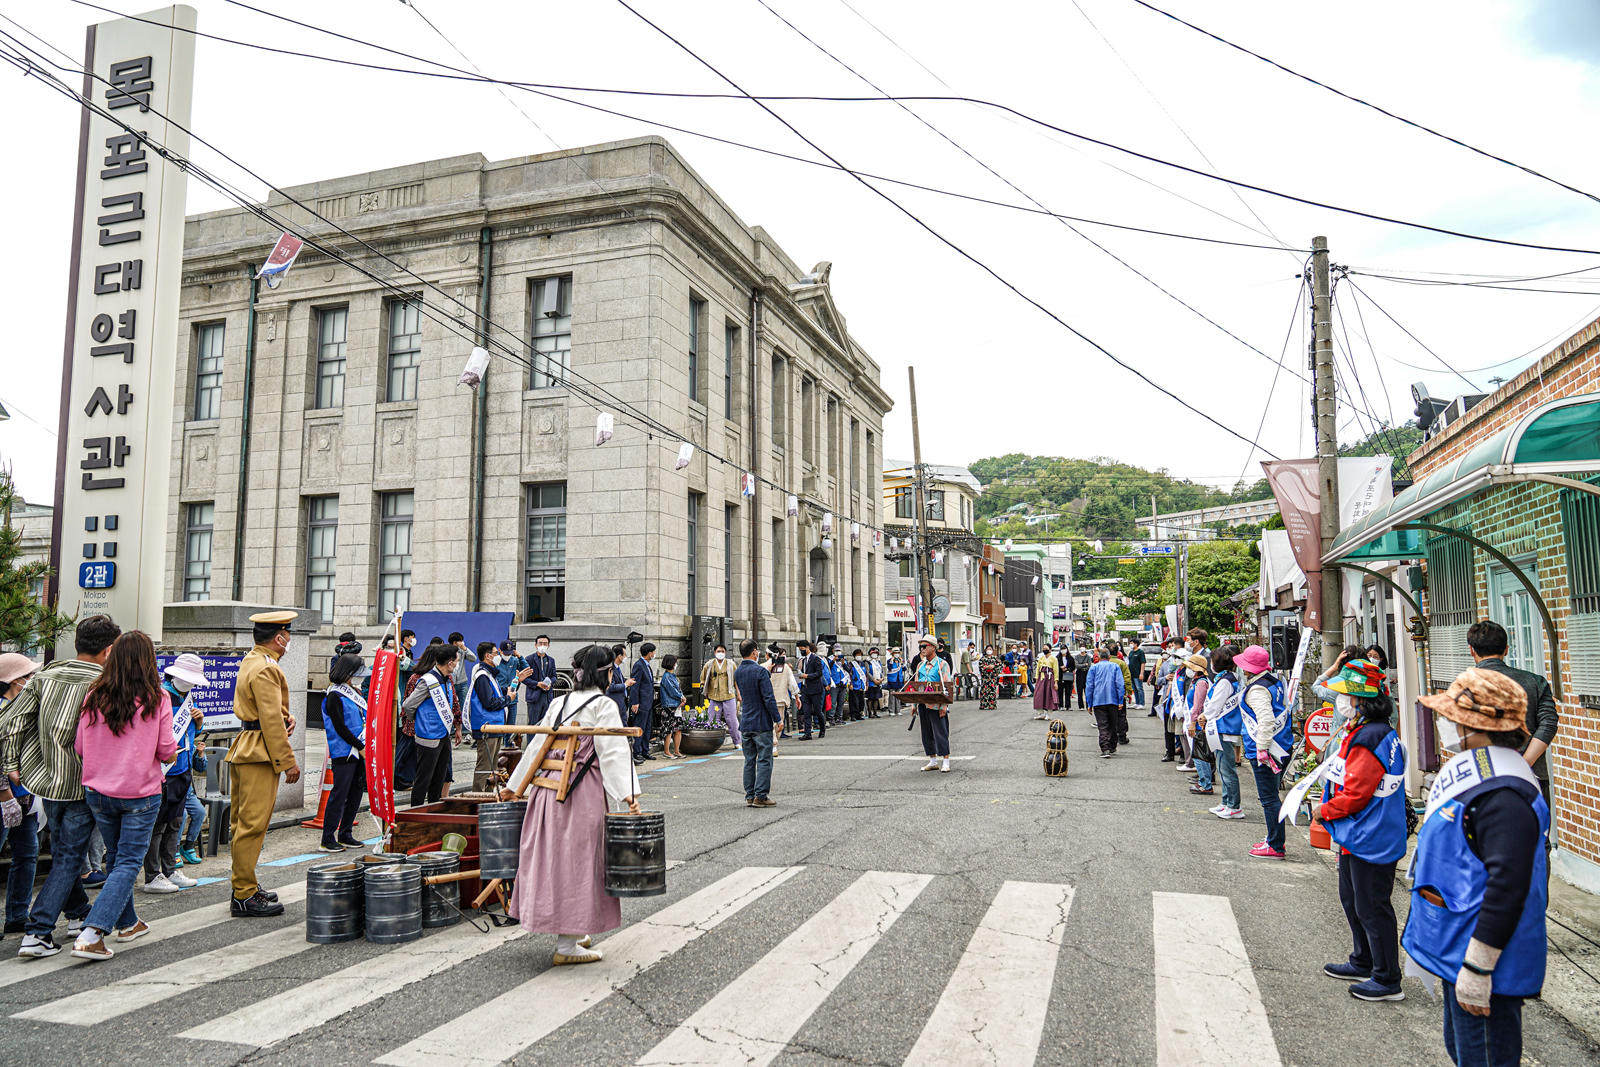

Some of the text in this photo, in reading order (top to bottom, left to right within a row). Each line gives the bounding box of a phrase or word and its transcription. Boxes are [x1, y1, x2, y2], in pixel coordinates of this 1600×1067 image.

[80, 56, 154, 490] 목포근대역사관
[85, 565, 108, 585] 2관
[83, 591, 107, 600] Mokpo
[83, 601, 109, 609] Modern
